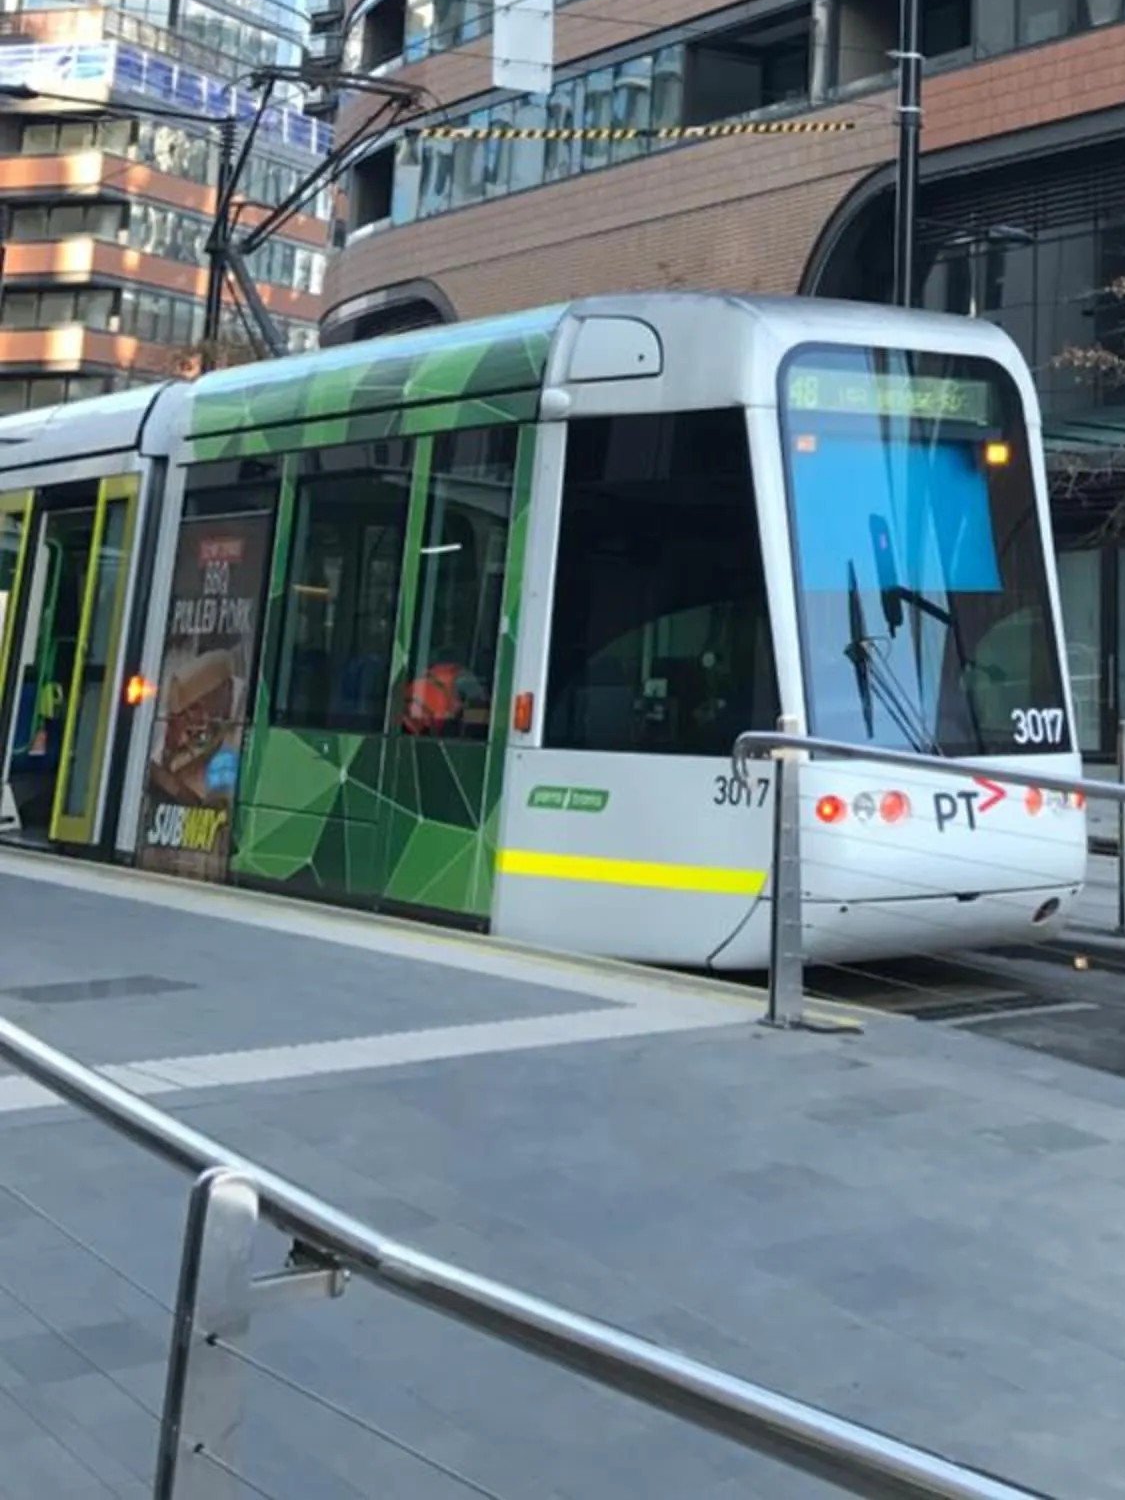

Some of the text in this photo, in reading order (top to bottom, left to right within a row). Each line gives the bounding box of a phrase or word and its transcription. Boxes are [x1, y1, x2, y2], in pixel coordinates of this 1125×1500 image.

[791, 376, 819, 409] 48
[1010, 707, 1064, 744] 3017
[713, 775, 771, 808] 3017
[147, 803, 227, 852] SUBWAY
